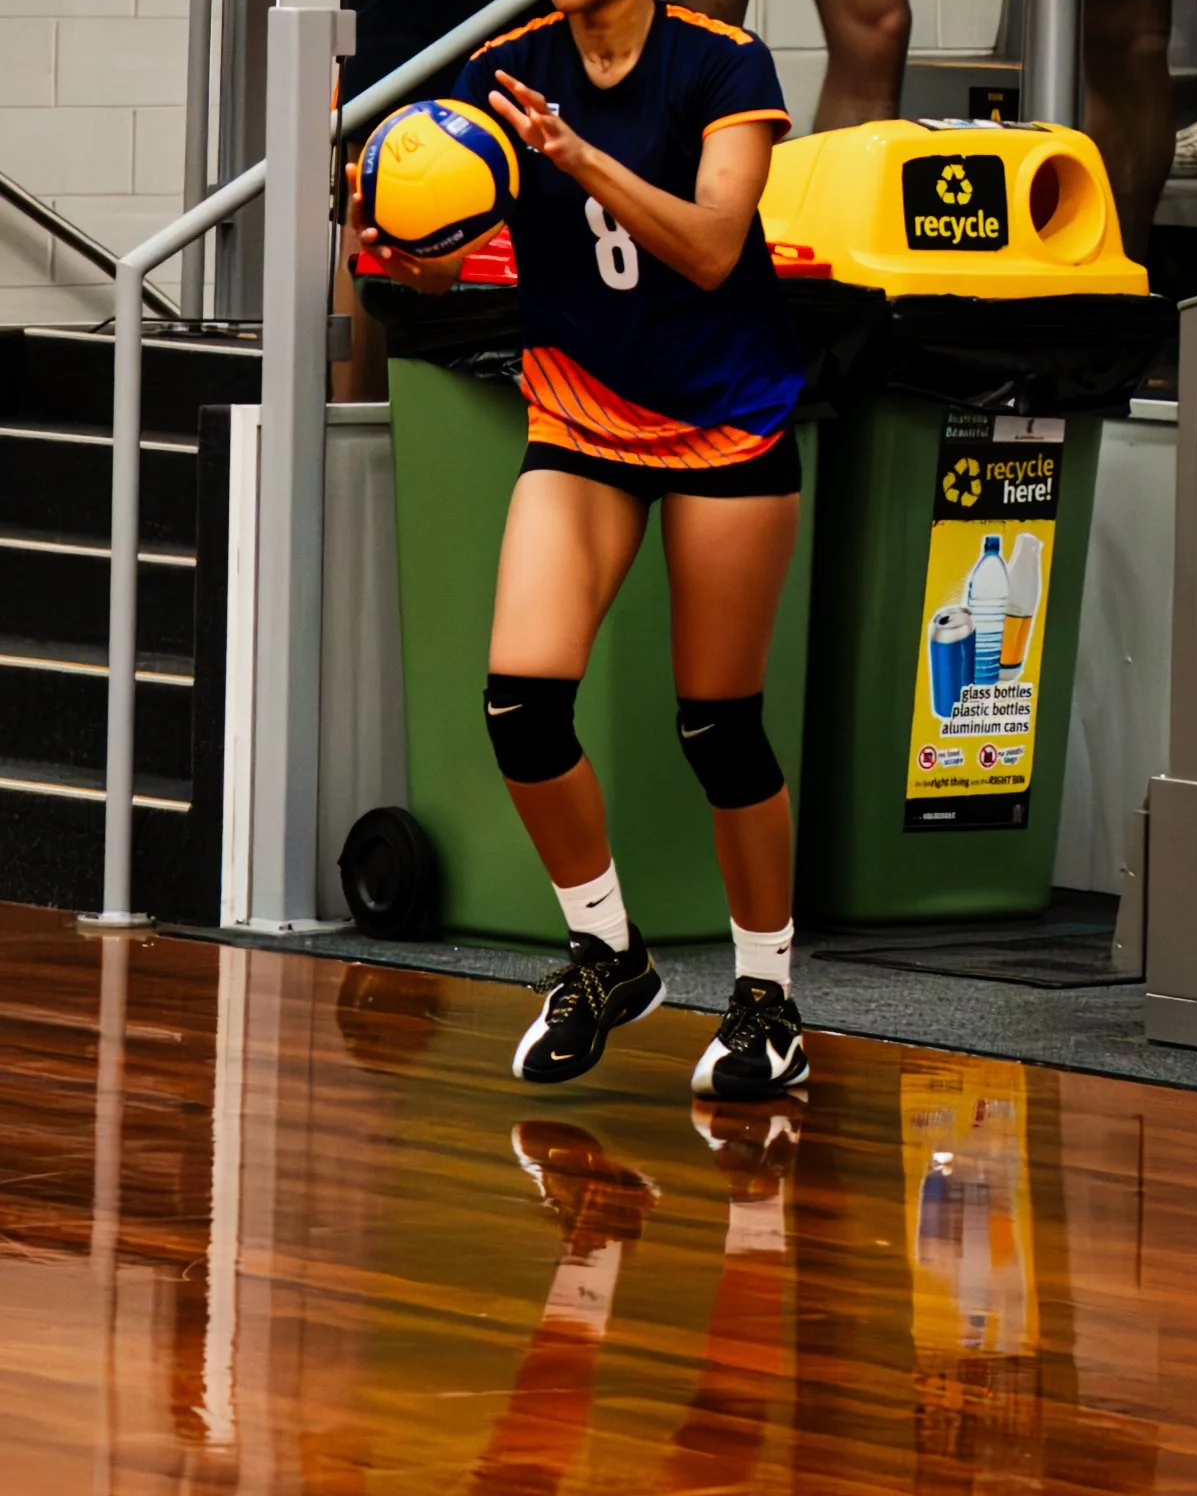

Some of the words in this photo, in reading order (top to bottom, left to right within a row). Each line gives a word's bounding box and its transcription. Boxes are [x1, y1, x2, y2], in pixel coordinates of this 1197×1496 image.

[914, 209, 999, 245] recycle
[584, 196, 639, 290] 8
[986, 452, 1054, 484] recycle
[1003, 477, 1052, 504] here!
[962, 686, 991, 702] glass
[993, 684, 1032, 699] bottles
[952, 704, 989, 719] plastic
[992, 703, 1030, 716] bottles
[941, 721, 1001, 735] aluminium
[1004, 723, 1029, 733] cans
